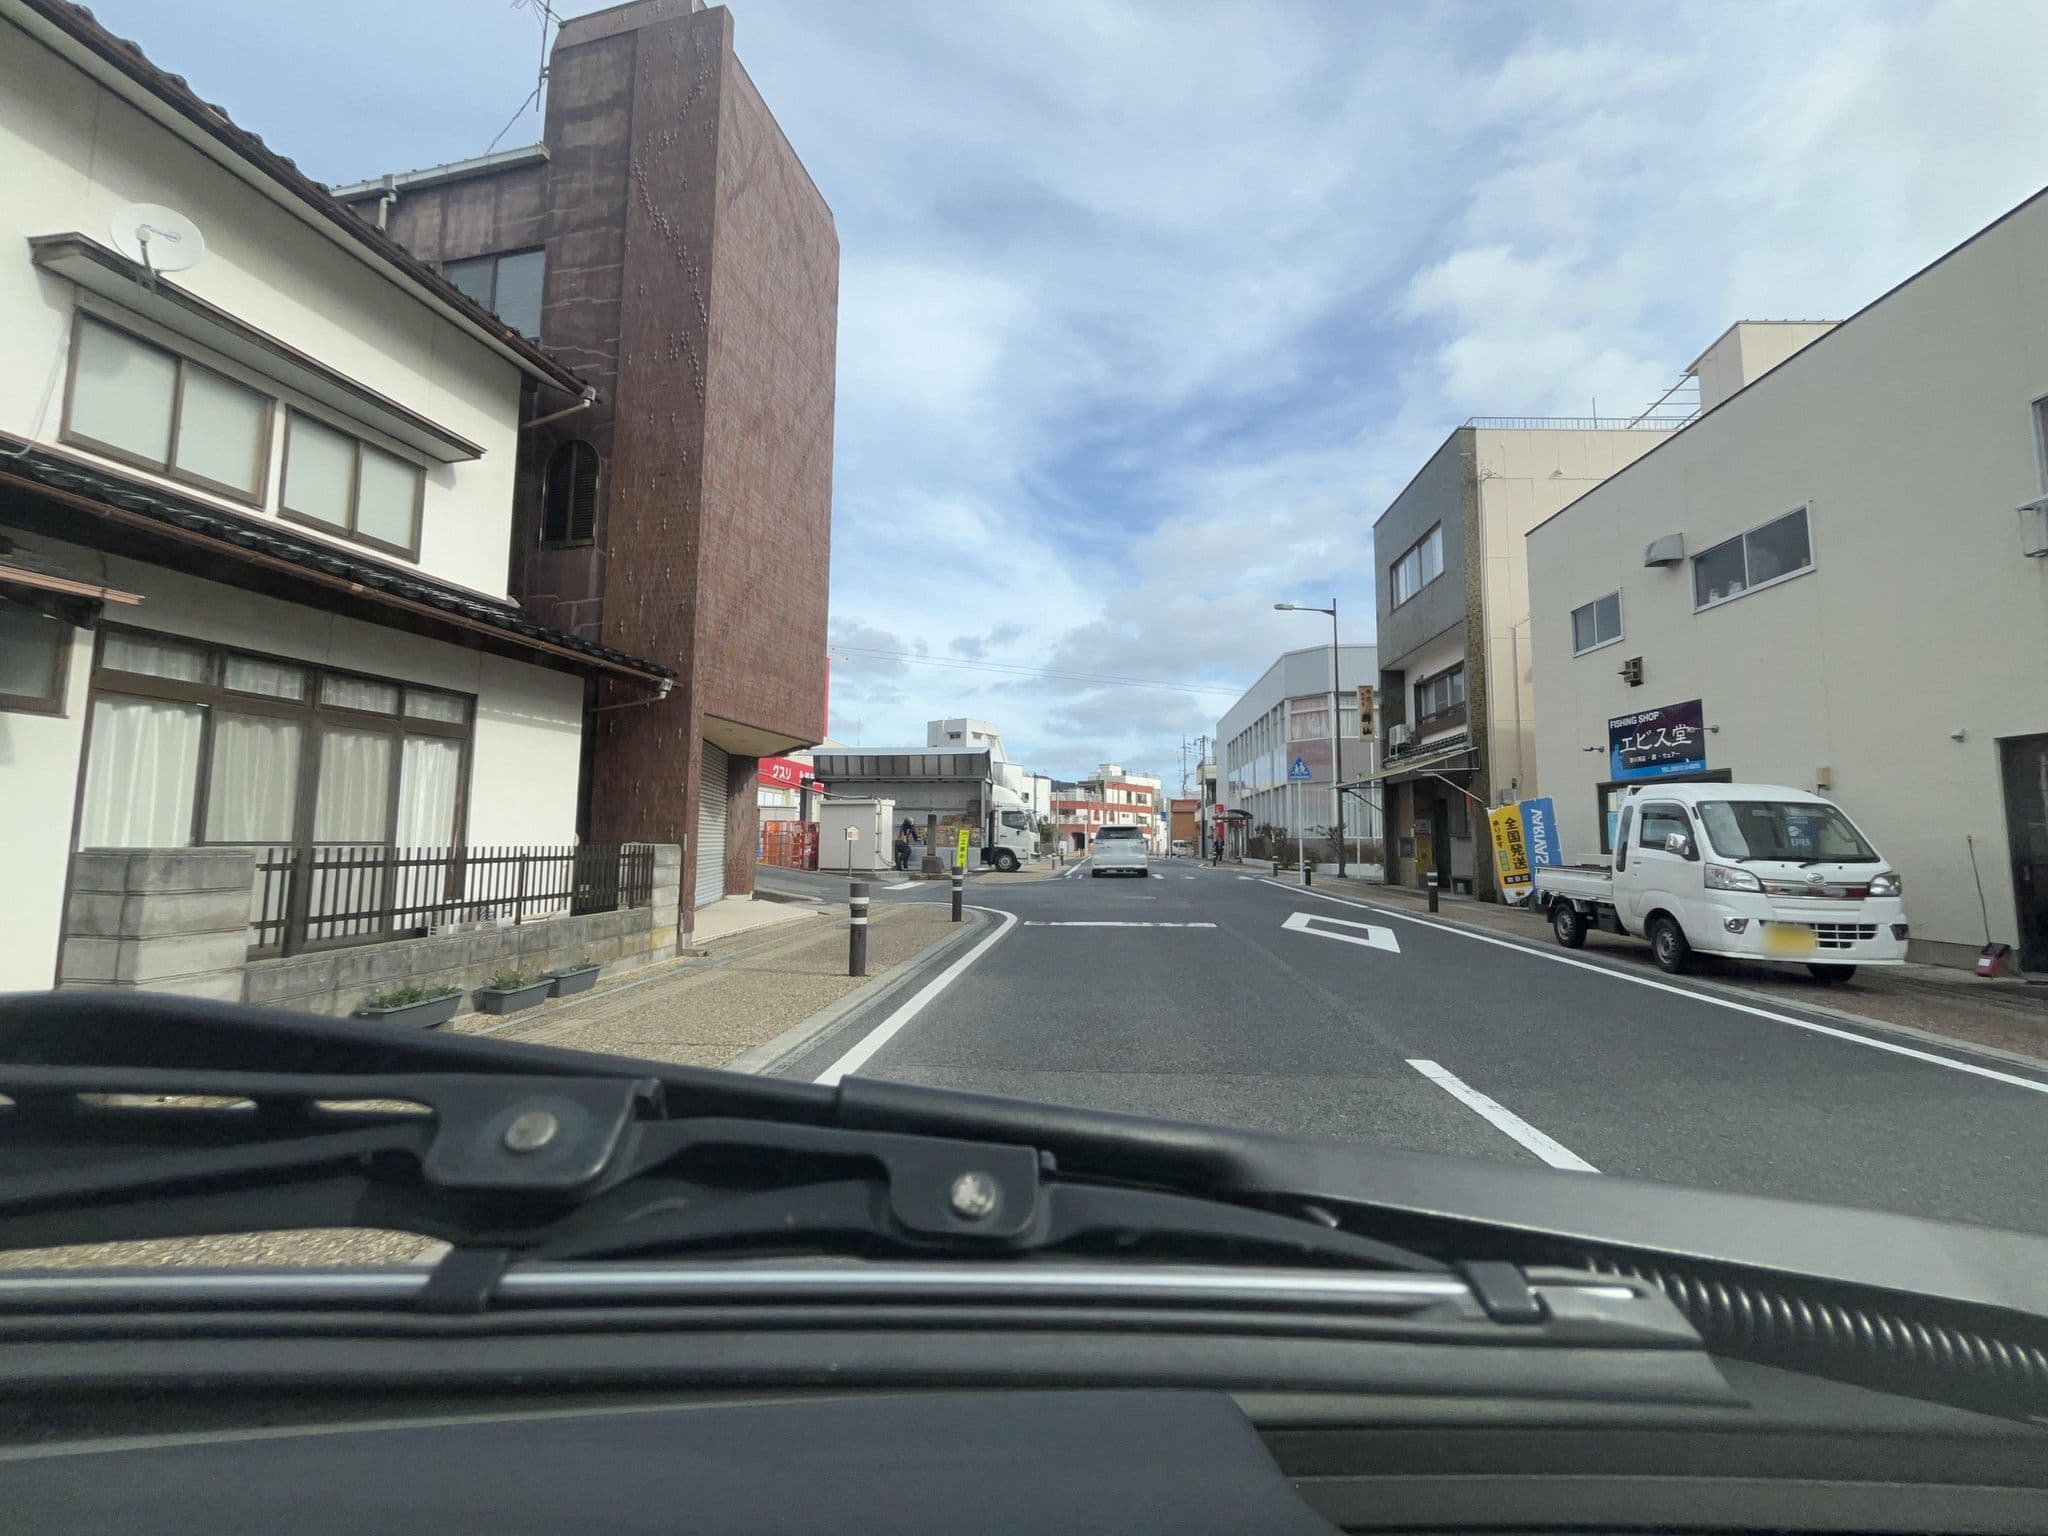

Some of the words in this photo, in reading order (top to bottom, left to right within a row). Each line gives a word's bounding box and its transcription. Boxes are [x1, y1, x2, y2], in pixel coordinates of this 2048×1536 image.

[1610, 716, 1637, 729] FISHING
[1638, 711, 1659, 723] SHOP
[1619, 723, 1692, 753] エビス堂
[773, 764, 791, 780] クスリ
[1505, 817, 1528, 870] 全国発送
